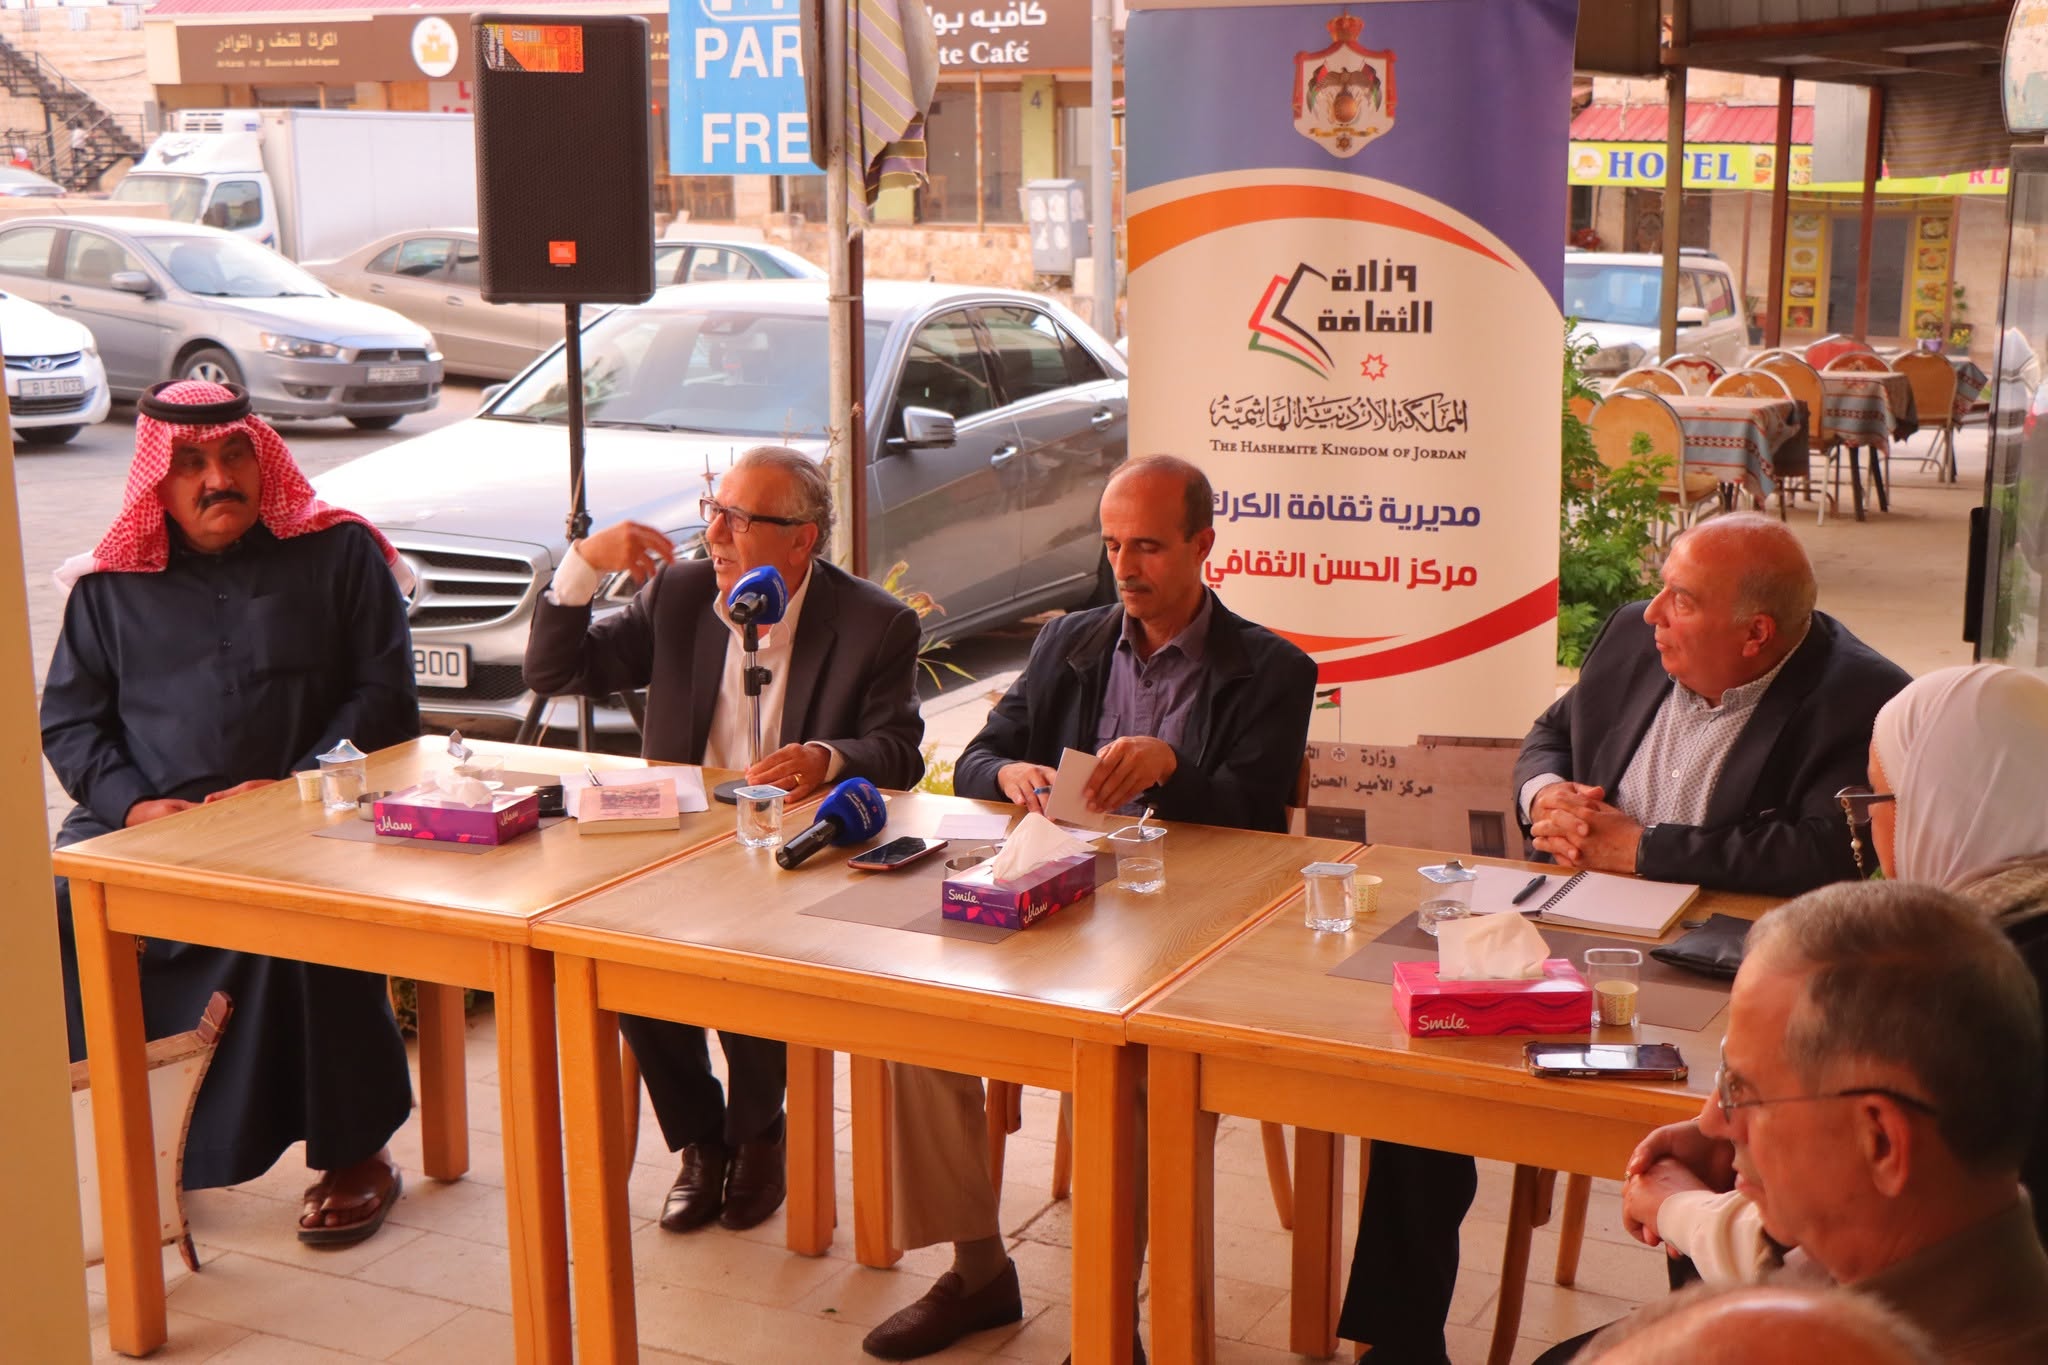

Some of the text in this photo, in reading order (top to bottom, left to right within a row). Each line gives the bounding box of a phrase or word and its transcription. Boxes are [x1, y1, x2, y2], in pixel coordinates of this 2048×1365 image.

[970, 1, 1047, 33] كافيه
[696, 26, 804, 79] PAR
[939, 40, 1029, 65] te Café
[1030, 90, 1042, 109] 4
[702, 112, 810, 163] FRE
[1608, 151, 1737, 181] HOEL
[1332, 258, 1416, 292] وزارة
[1318, 300, 1432, 333] الثقافة
[1210, 439, 1467, 461] THE HASHEMITE KINGDOM OF JORDAN
[1212, 490, 1481, 532] مديرية ثقافة الكرك
[1204, 549, 1478, 591] مركز الحسن الثقافي
[1360, 749, 1396, 768] وزارة
[1310, 774, 1347, 789] الحسن
[1398, 781, 1433, 797] مركز
[948, 889, 979, 903] Smile
